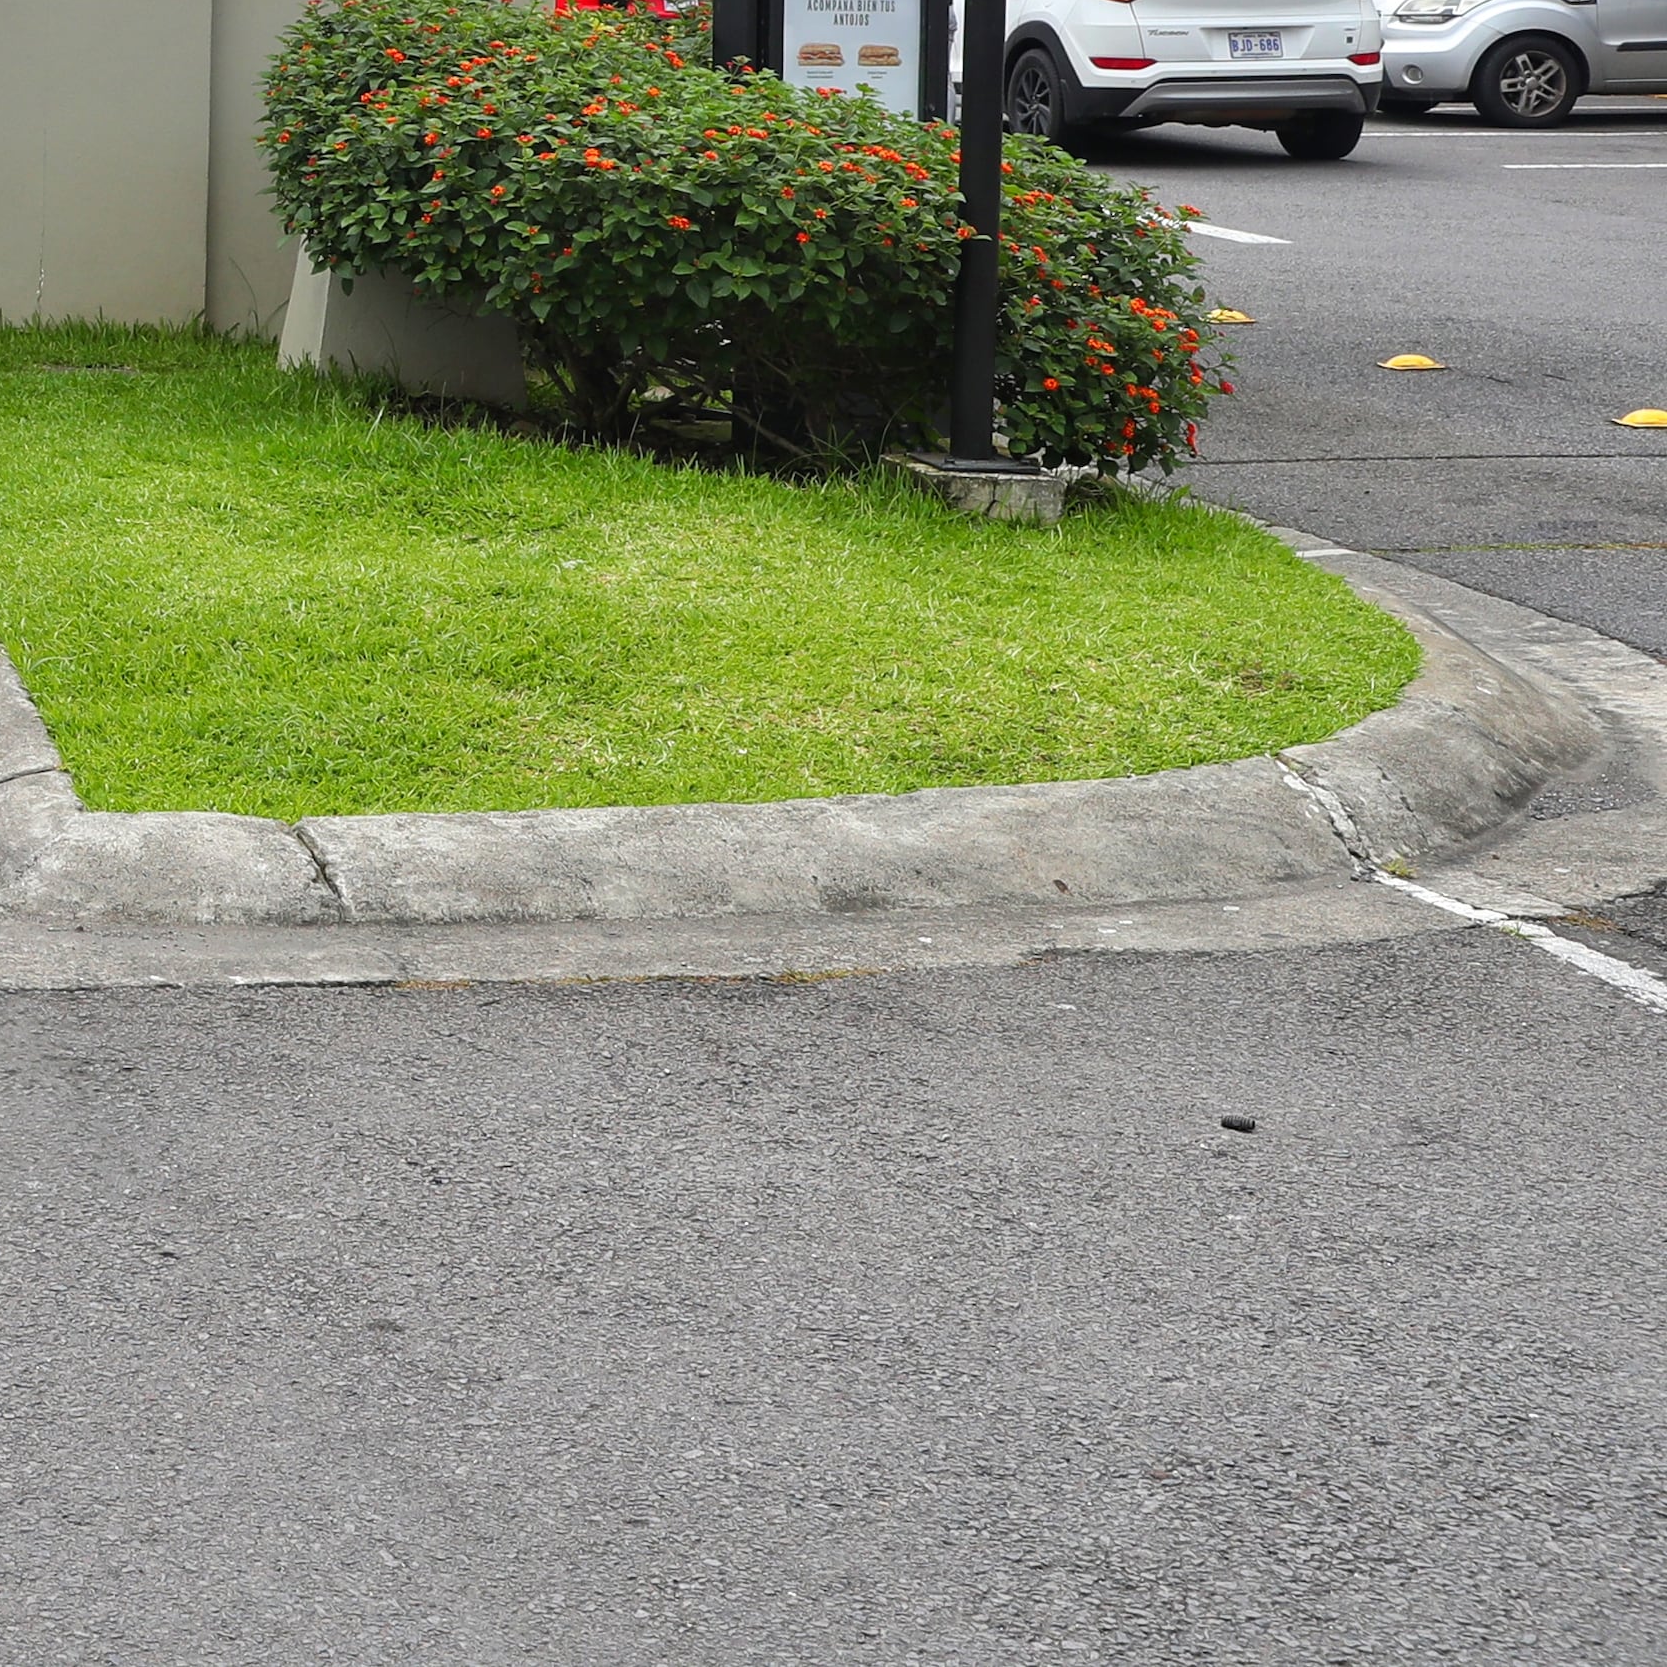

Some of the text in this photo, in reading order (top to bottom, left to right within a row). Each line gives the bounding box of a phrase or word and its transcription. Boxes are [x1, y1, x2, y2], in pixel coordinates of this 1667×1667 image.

[857, 0, 877, 12] BIEN
[880, 1, 896, 12] TUS
[833, 14, 870, 26] ANTOJOS
[1231, 38, 1280, 52] BJD-686
